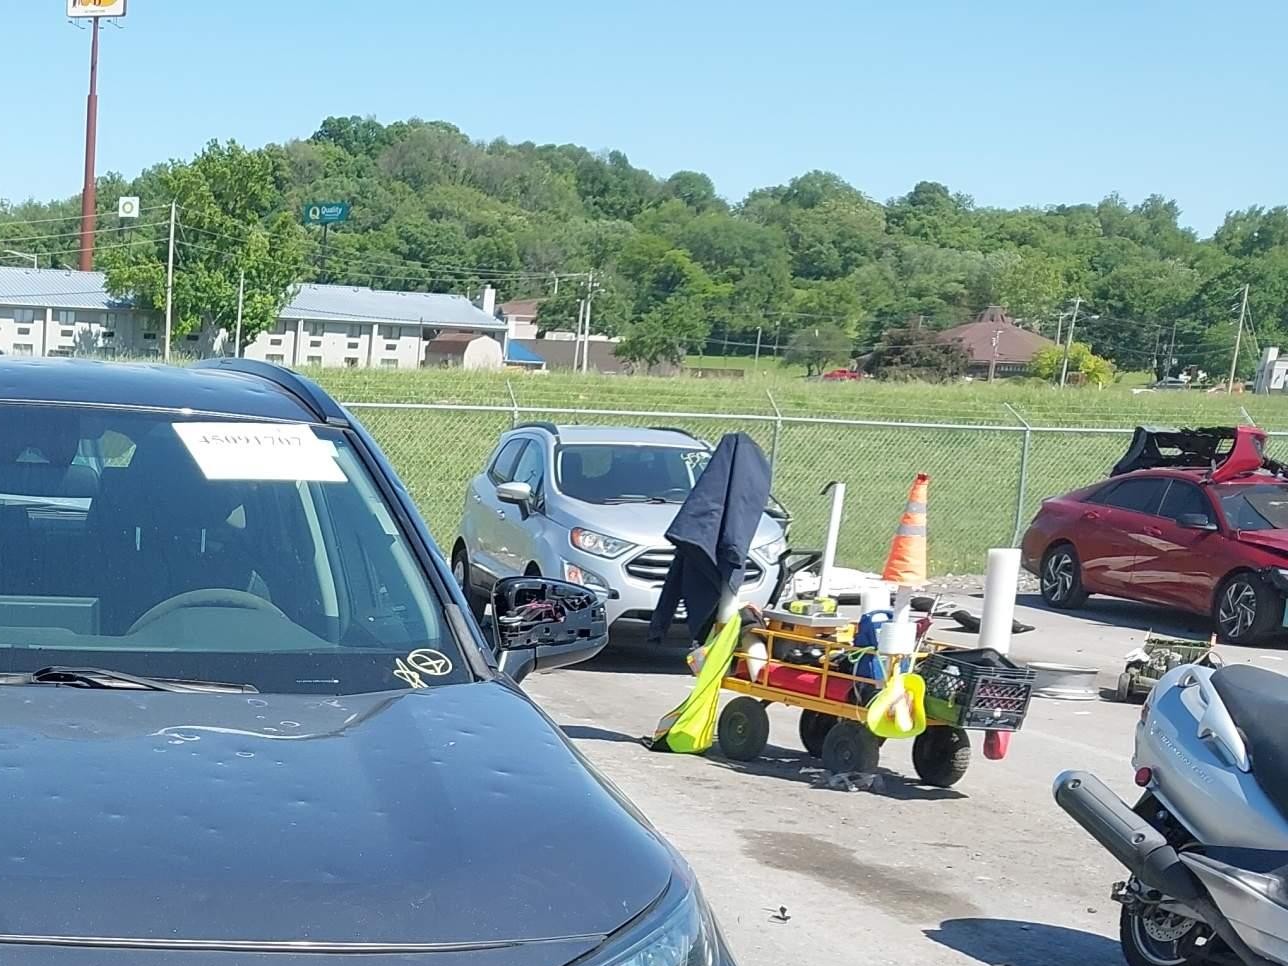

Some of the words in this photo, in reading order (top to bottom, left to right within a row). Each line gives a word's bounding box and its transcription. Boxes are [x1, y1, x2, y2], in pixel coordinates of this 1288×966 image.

[309, 206, 320, 219] Q
[321, 206, 342, 216] Quality
[198, 434, 302, 447] 45091707
